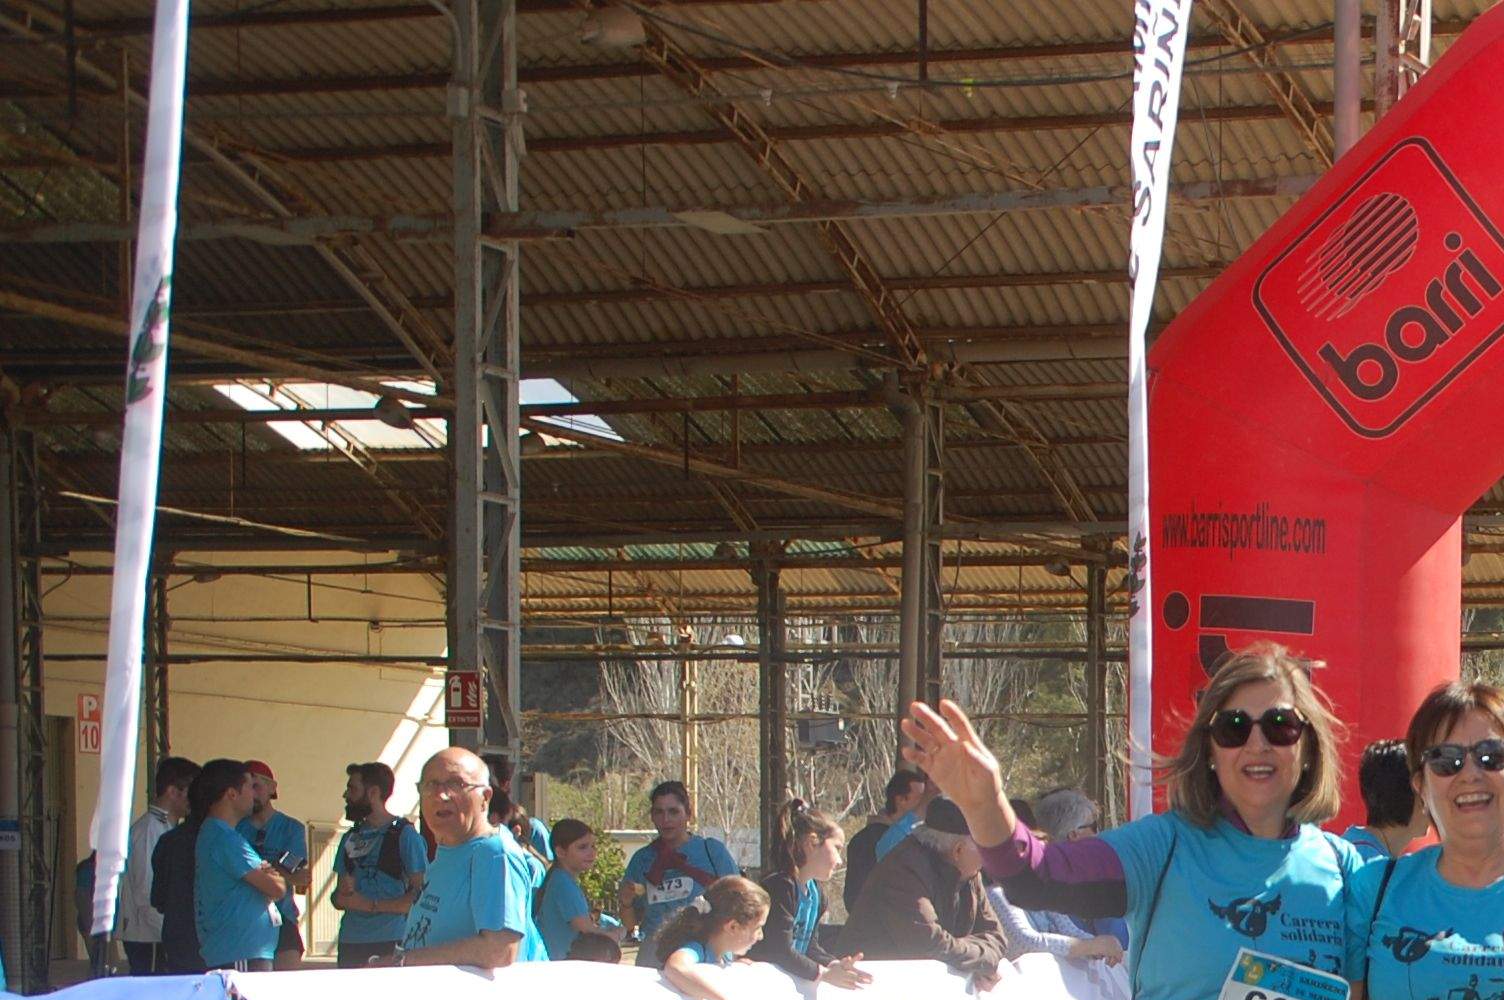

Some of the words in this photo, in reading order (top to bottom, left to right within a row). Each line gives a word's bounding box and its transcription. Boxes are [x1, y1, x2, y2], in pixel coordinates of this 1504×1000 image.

[1132, 0, 1181, 227] SARIÑ
[1318, 232, 1504, 400] barri
[1162, 501, 1327, 559] www.barrisportline.com
[82, 695, 97, 719] P
[82, 725, 99, 749] 10
